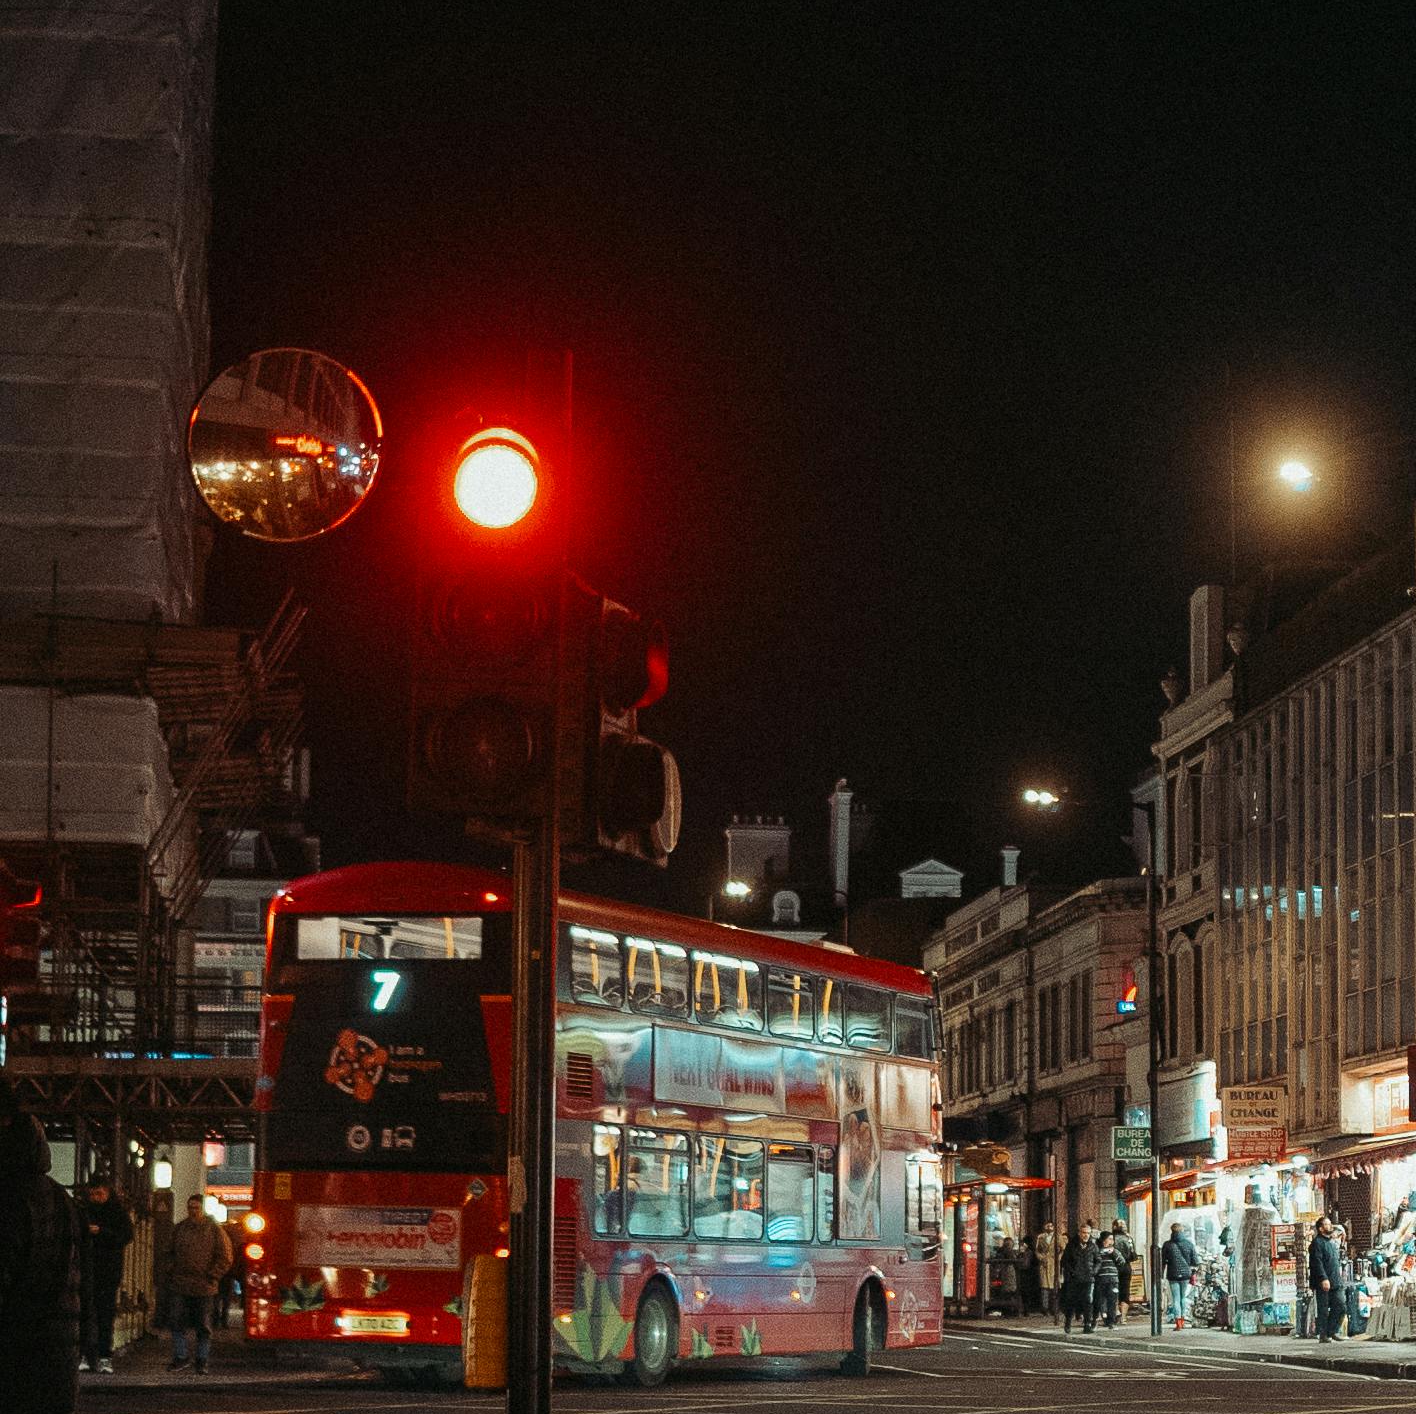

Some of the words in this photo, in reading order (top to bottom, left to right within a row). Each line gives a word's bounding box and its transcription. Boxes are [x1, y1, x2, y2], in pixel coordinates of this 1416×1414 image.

[372, 970, 401, 1011] 7
[1230, 1090, 1278, 1101] BUREAU
[1230, 1109, 1279, 1118] CHANGE
[1117, 1129, 1151, 1138] BUREA
[1261, 1129, 1284, 1137] SHOP
[1130, 1139, 1144, 1148] DE
[1116, 1148, 1152, 1157] CHANG
